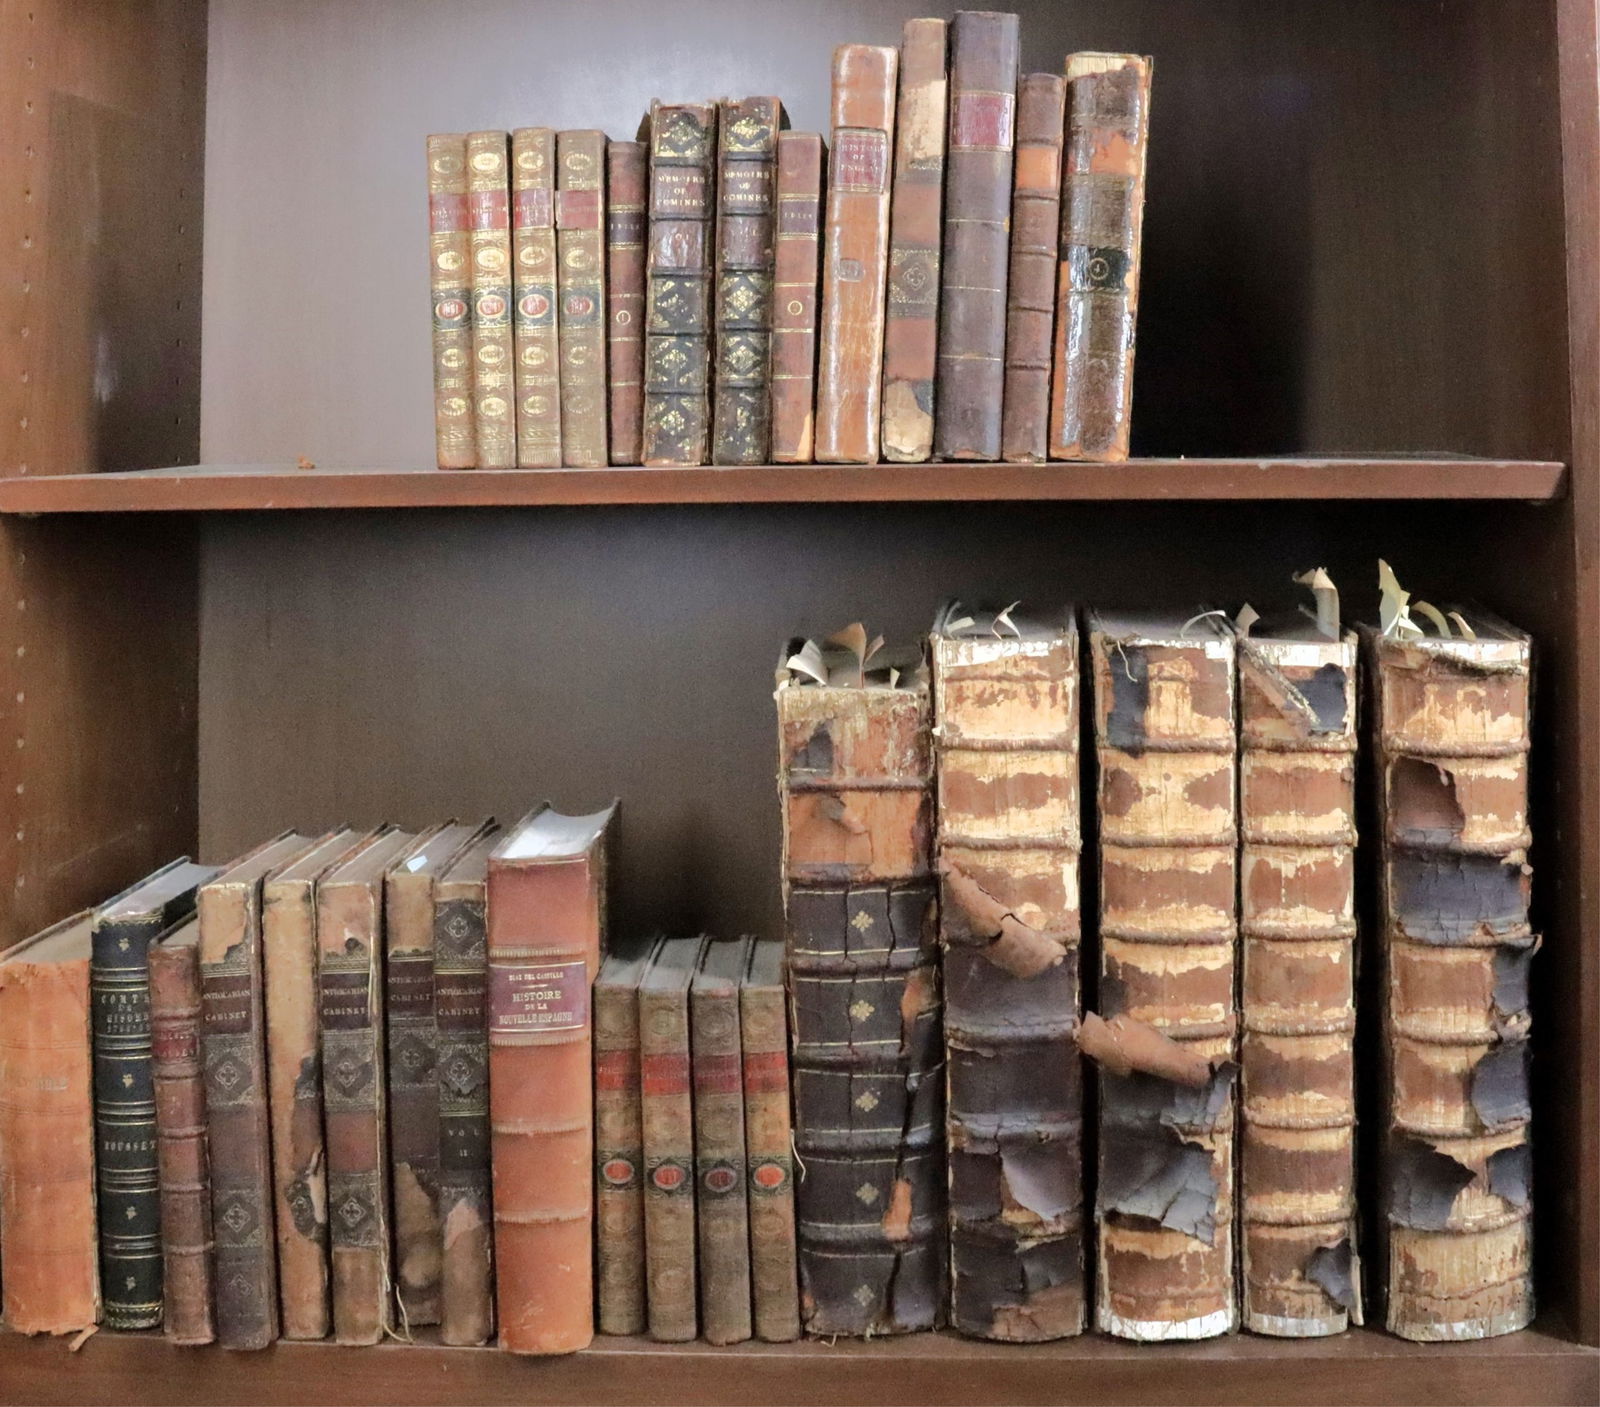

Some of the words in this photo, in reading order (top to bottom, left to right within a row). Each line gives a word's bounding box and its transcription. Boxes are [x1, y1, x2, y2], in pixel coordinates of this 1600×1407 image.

[724, 170, 770, 180] MEMOIRS
[738, 181, 751, 190] OF
[673, 186, 687, 196] OF
[723, 193, 769, 202] COMINES
[512, 990, 562, 1004] HISTOIRE
[323, 1007, 366, 1016] CABINET
[524, 1003, 535, 1011] DE
[537, 1002, 547, 1010] LA
[205, 1010, 247, 1021] CABINET
[438, 1007, 480, 1017] CABINET
[499, 1013, 538, 1025] NOUVELLE
[538, 1011, 573, 1023] ESPAGNE
